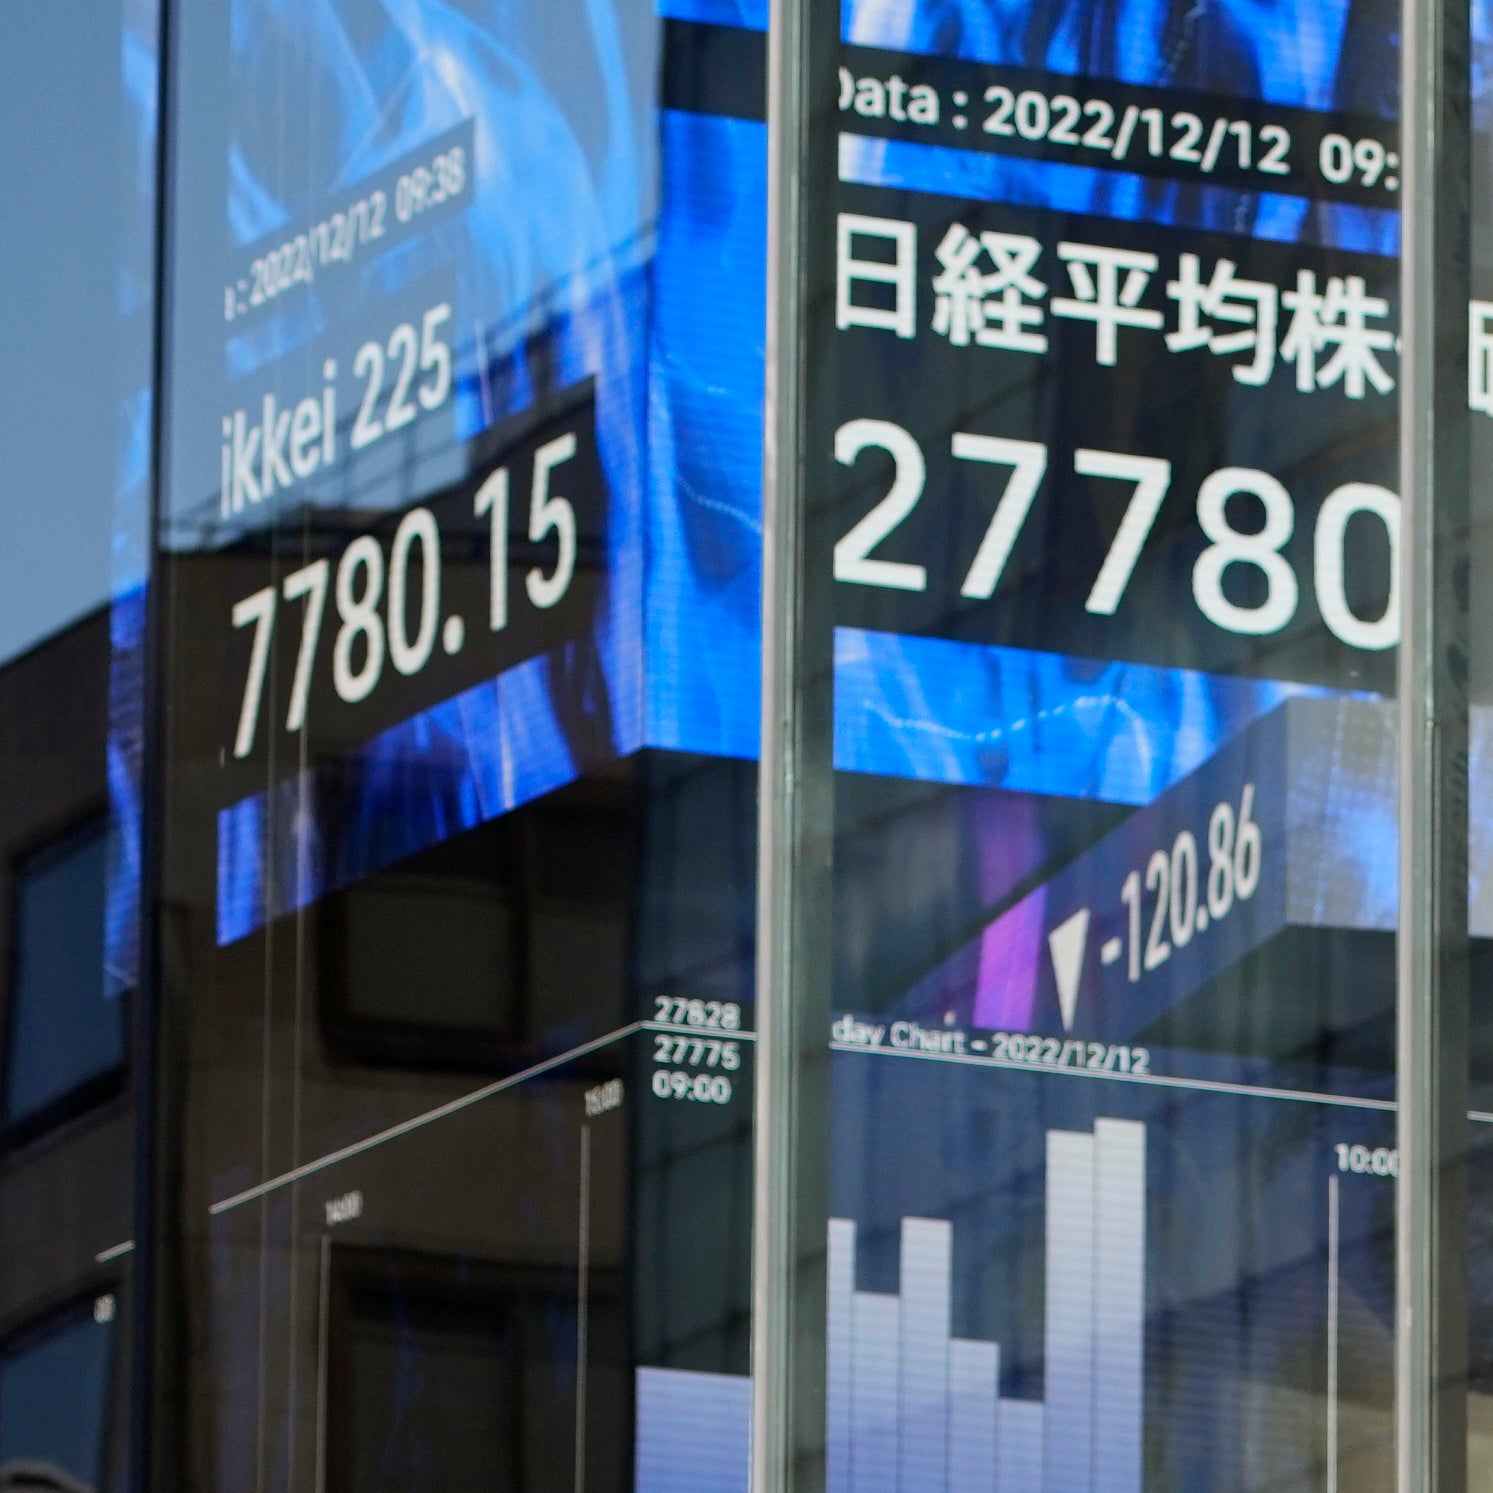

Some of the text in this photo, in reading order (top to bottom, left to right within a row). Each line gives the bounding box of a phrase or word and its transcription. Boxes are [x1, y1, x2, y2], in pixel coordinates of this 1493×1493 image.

[983, 84, 1291, 176] 2022/12/12
[1319, 133, 1399, 190] 09:
[395, 146, 465, 223] 09:38
[352, 305, 453, 447] 225
[222, 433, 577, 765] 7780.15
[1100, 783, 1261, 982] -120.86
[654, 995, 740, 1030] 27828
[890, 1021, 966, 1054] Chart
[992, 1032, 1151, 1074] 2022/12/12
[652, 1070, 731, 1104] 09:00
[653, 1034, 740, 1070] 27775
